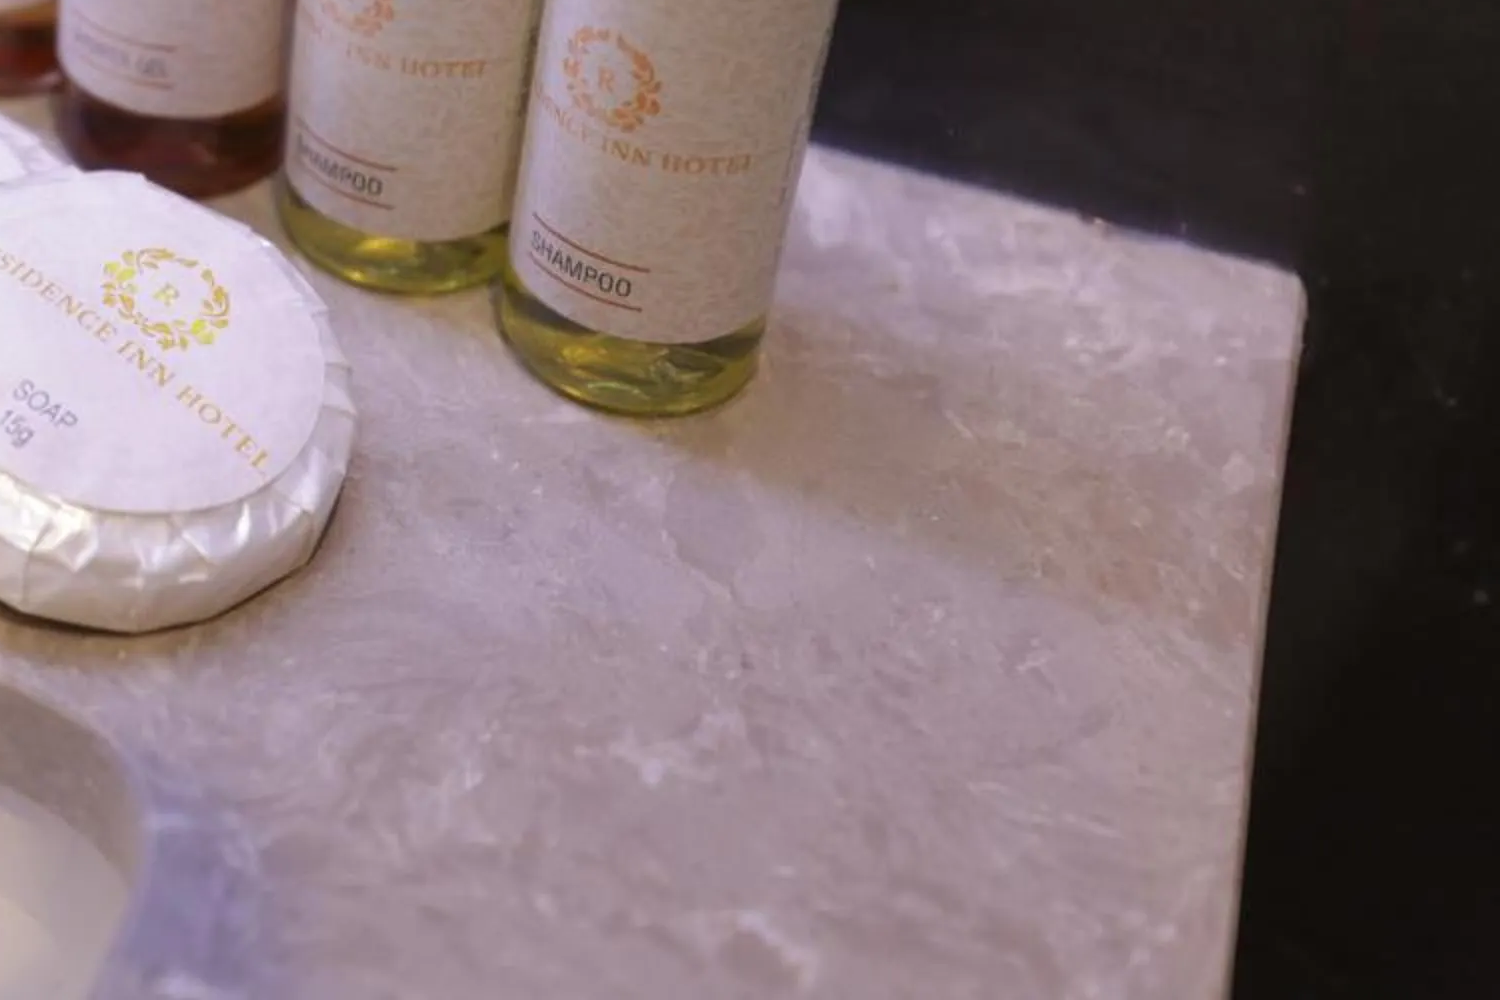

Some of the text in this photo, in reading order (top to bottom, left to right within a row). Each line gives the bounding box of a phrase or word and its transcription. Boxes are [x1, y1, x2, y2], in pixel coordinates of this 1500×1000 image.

[600, 138, 650, 168] INN
[660, 152, 757, 176] HOTEL
[530, 230, 633, 298] SHAMPOO
[13, 378, 79, 430] SOAP
[116, 339, 176, 388] INN
[175, 384, 269, 482] HOTEL
